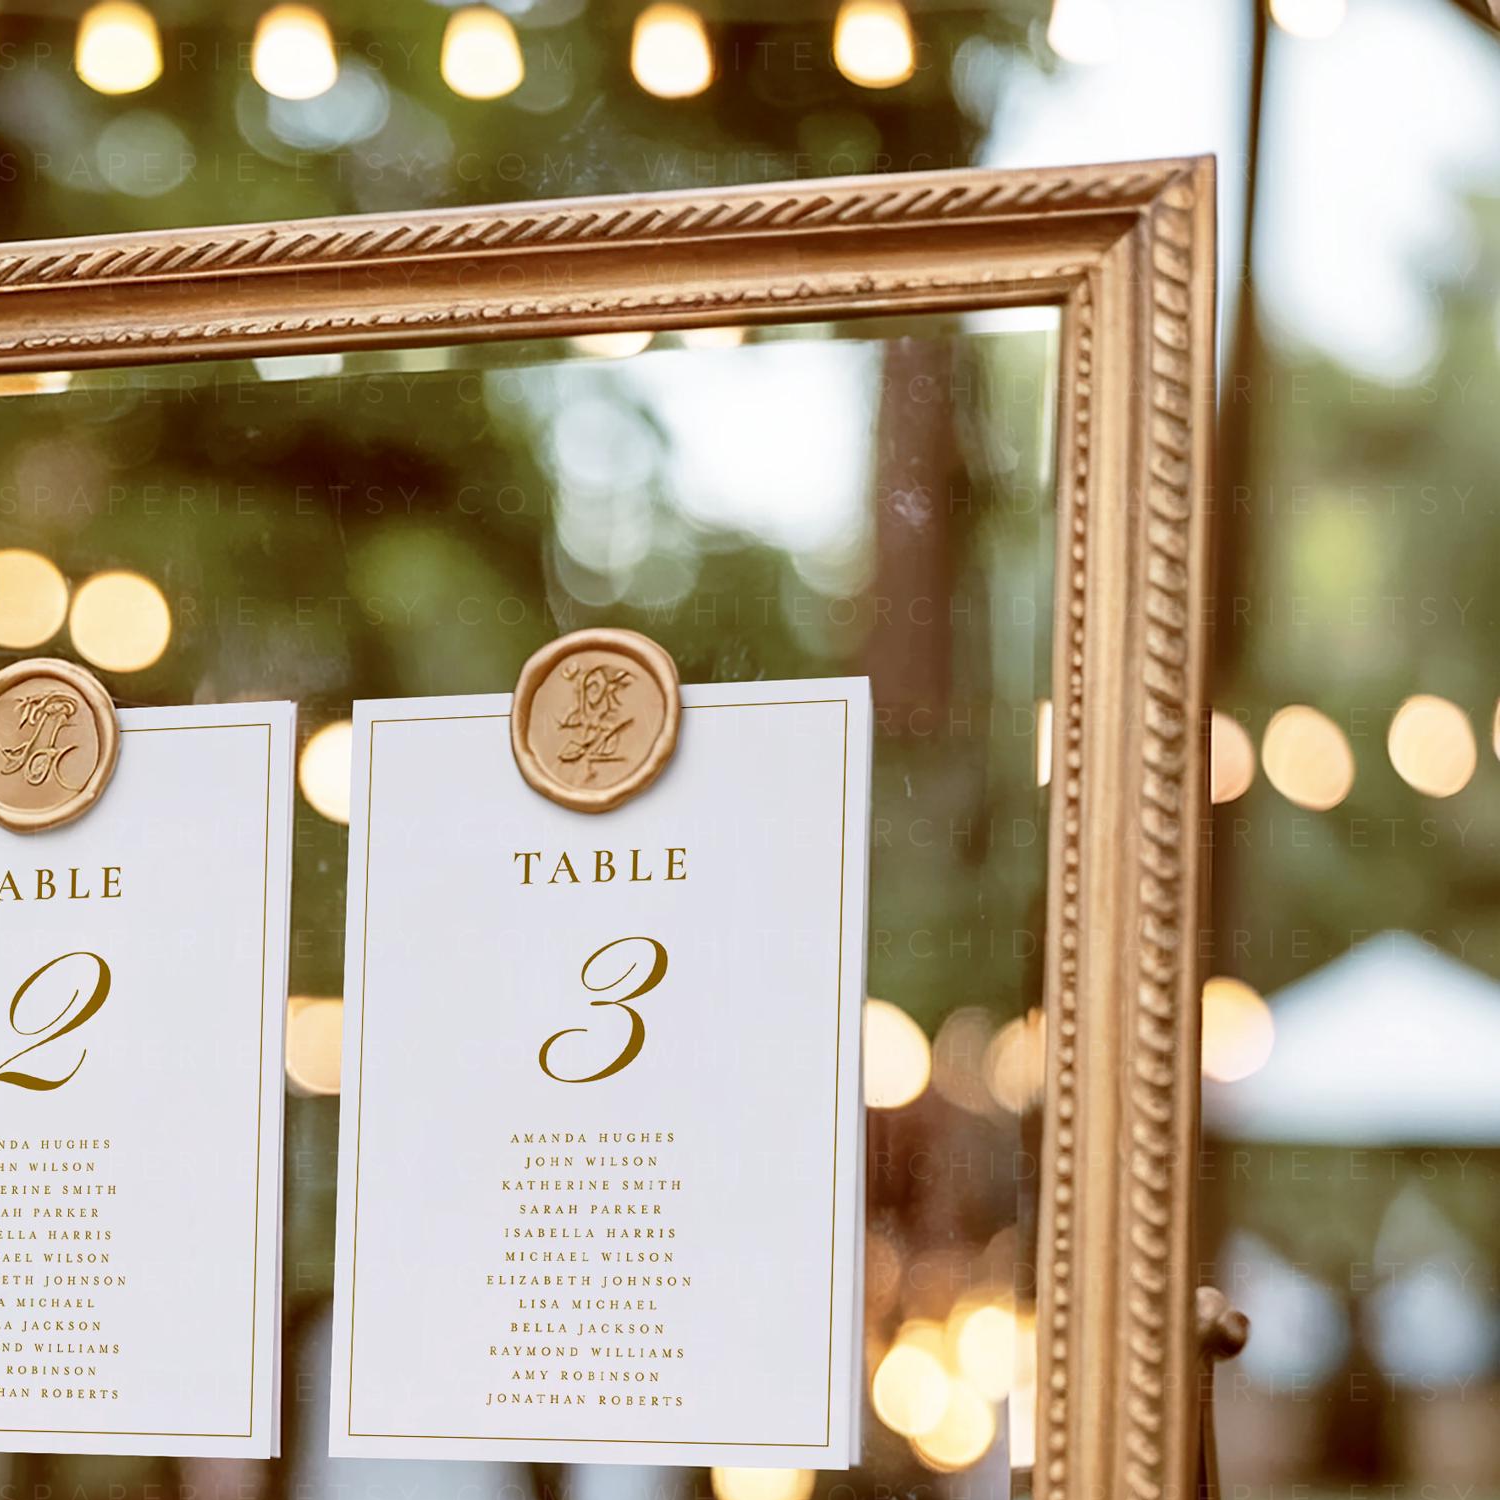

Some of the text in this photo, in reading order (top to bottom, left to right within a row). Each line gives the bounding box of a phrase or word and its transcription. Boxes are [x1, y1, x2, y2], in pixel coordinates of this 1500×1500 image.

[514, 848, 686, 885] TABLE
[538, 937, 668, 1084] 3
[510, 1132, 674, 1144] AMANDA HUGHES
[41, 1139, 110, 1150] HUGHES
[29, 1162, 95, 1172] WILSON
[524, 1156, 657, 1170] JOHN WILSON
[62, 1184, 116, 1195] SMITH
[502, 1180, 681, 1191] KATHERINE SMITH
[33, 1207, 98, 1218] PARKER
[519, 1204, 661, 1215] SARAH PARKER
[48, 1230, 112, 1241] HARRIS
[504, 1227, 675, 1239] ISABELLA HARRIS
[43, 1253, 109, 1264] WILSON
[505, 1251, 673, 1263] MICHAEL WILSON
[43, 1275, 126, 1288] JOHNSON
[486, 1275, 691, 1289] ELIZABETH JOHNSON
[16, 1297, 95, 1308] MICHAEL
[519, 1298, 657, 1311] LISA MICHAEL
[21, 1320, 101, 1333] JACKSON
[510, 1322, 664, 1336] BELLA JACKSON
[34, 1343, 120, 1354] WILLIAMS
[489, 1345, 684, 1359] RAYMOND WILLIAMS
[6, 1365, 96, 1376] ROBINSON
[511, 1369, 659, 1382] AMY ROBINSON
[41, 1388, 118, 1400] ROBERTS
[486, 1393, 683, 1407] JONATHAN ROBERTS
